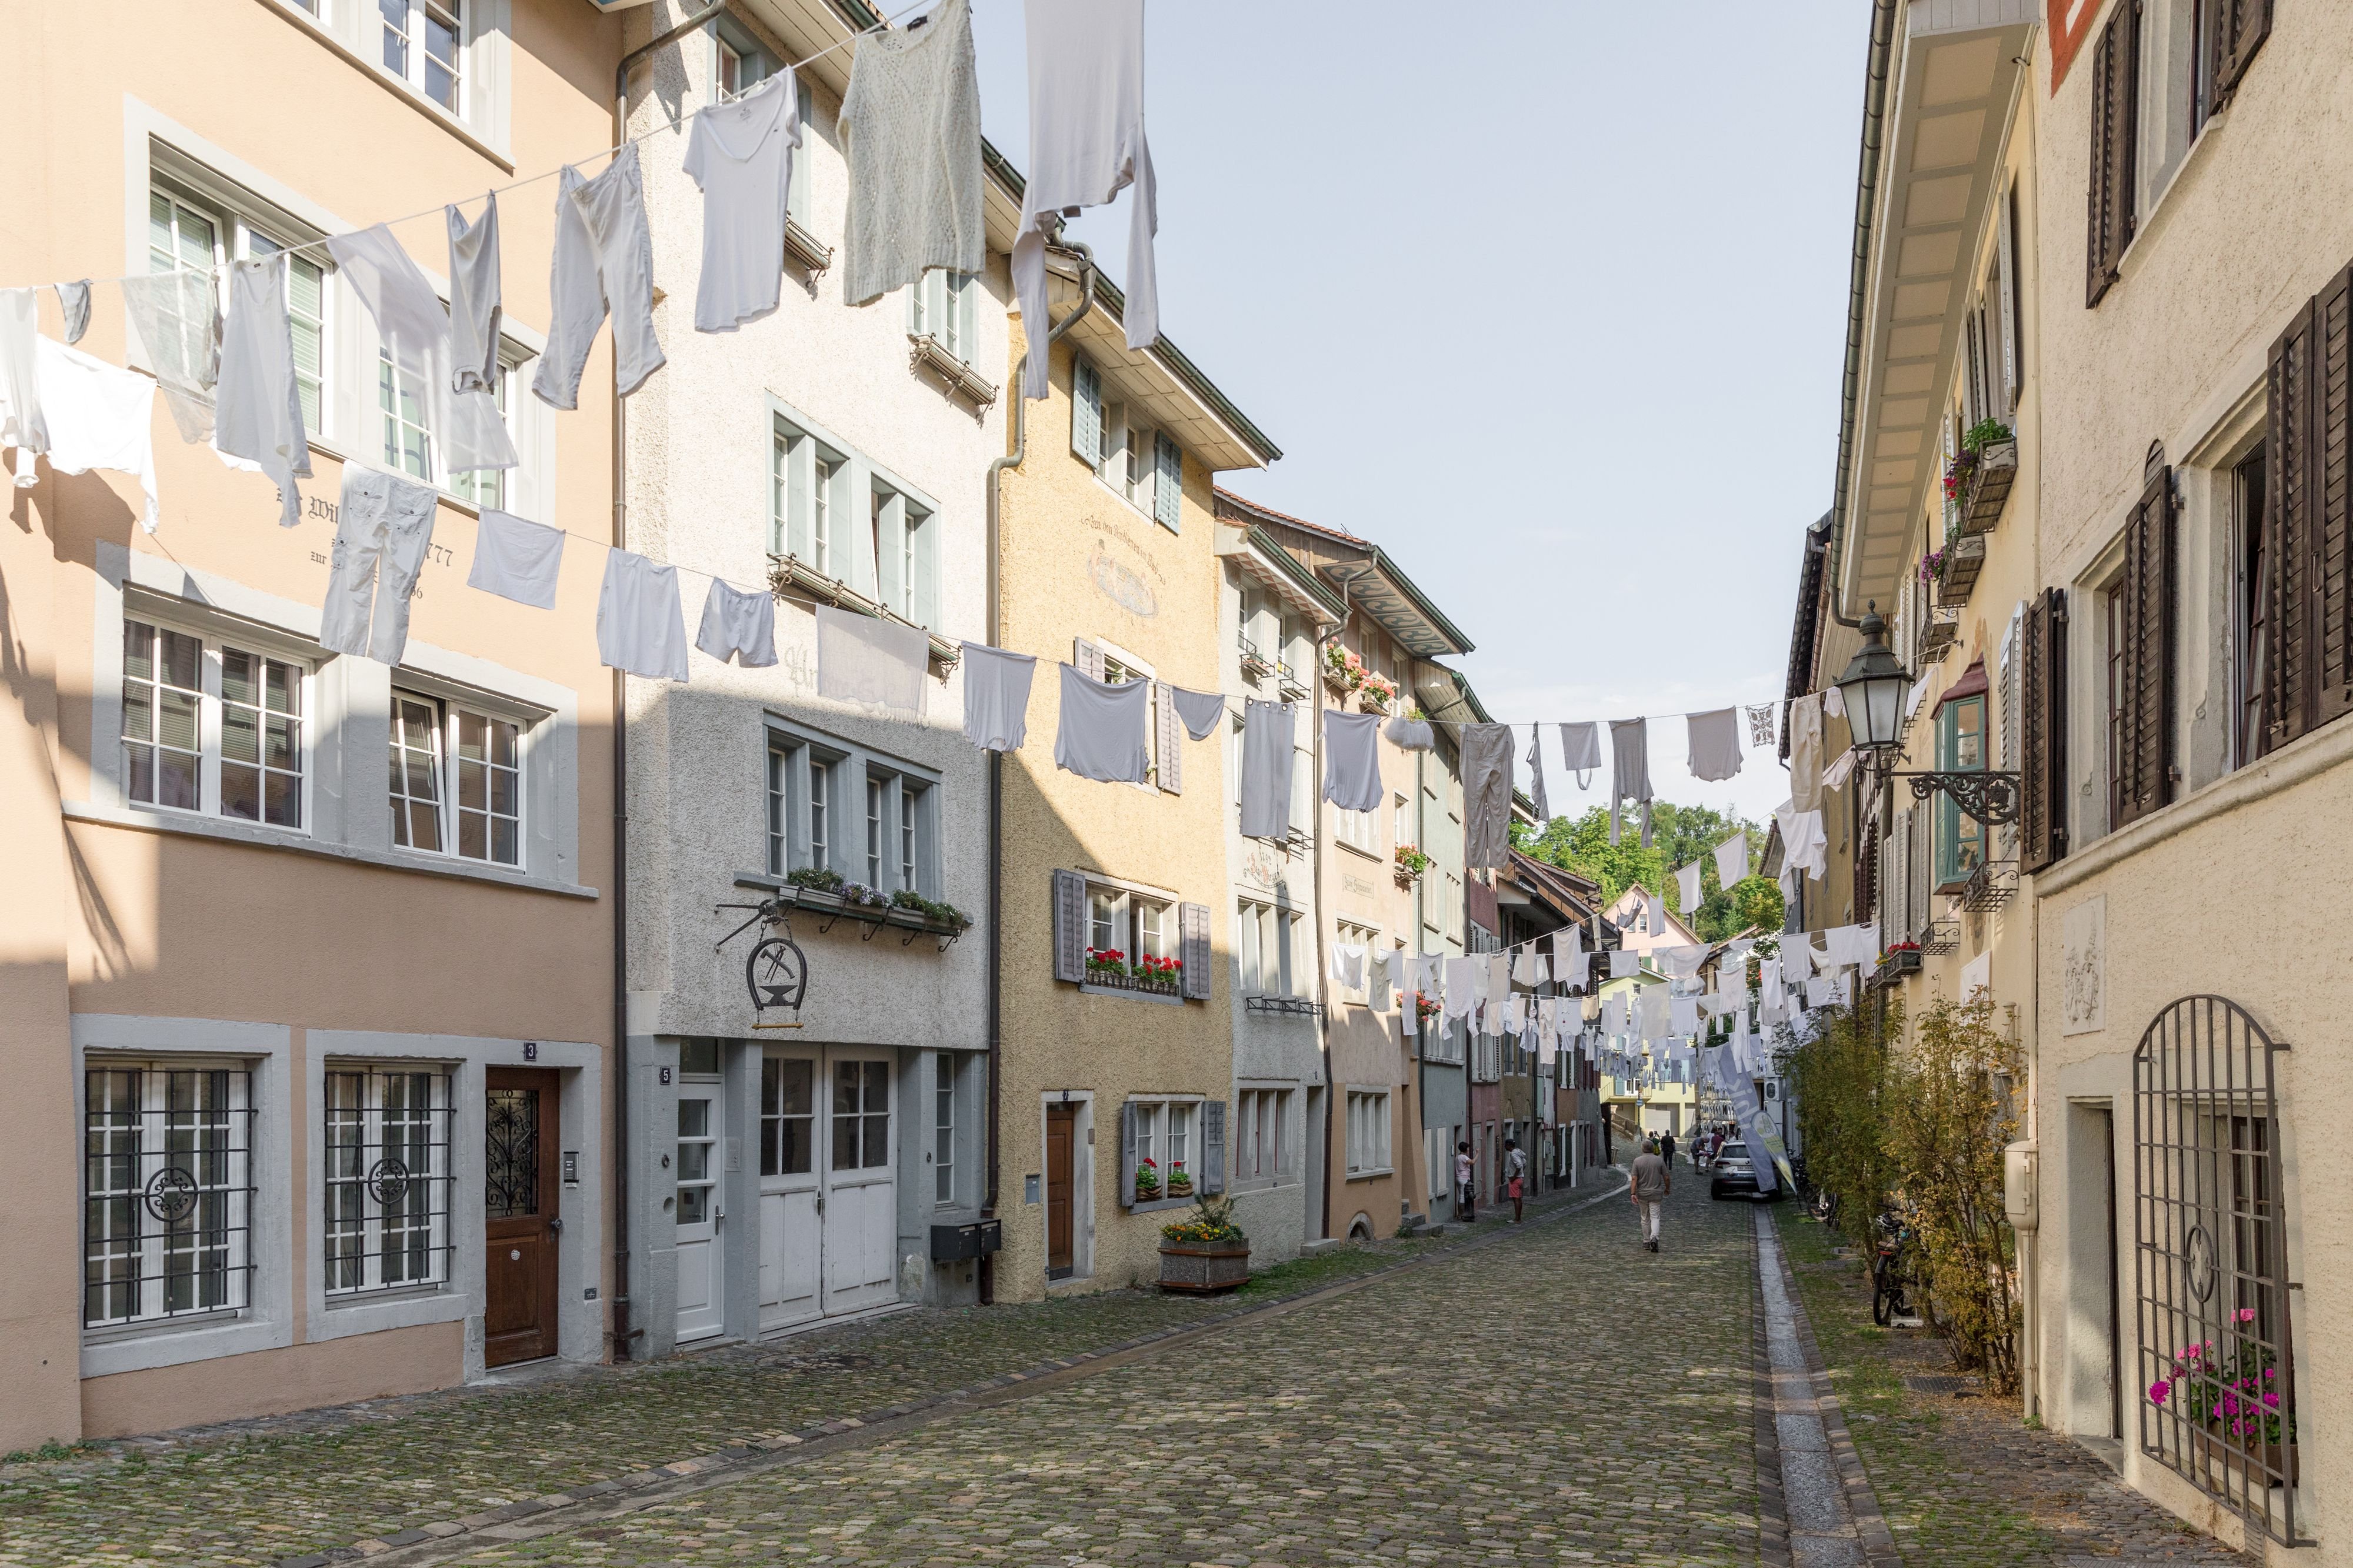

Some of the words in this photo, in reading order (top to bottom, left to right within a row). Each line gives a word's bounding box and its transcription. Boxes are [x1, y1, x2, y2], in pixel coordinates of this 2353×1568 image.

[426, 542, 453, 566] 777
[528, 1045, 534, 1057] 3
[664, 1070, 668, 1081] 5
